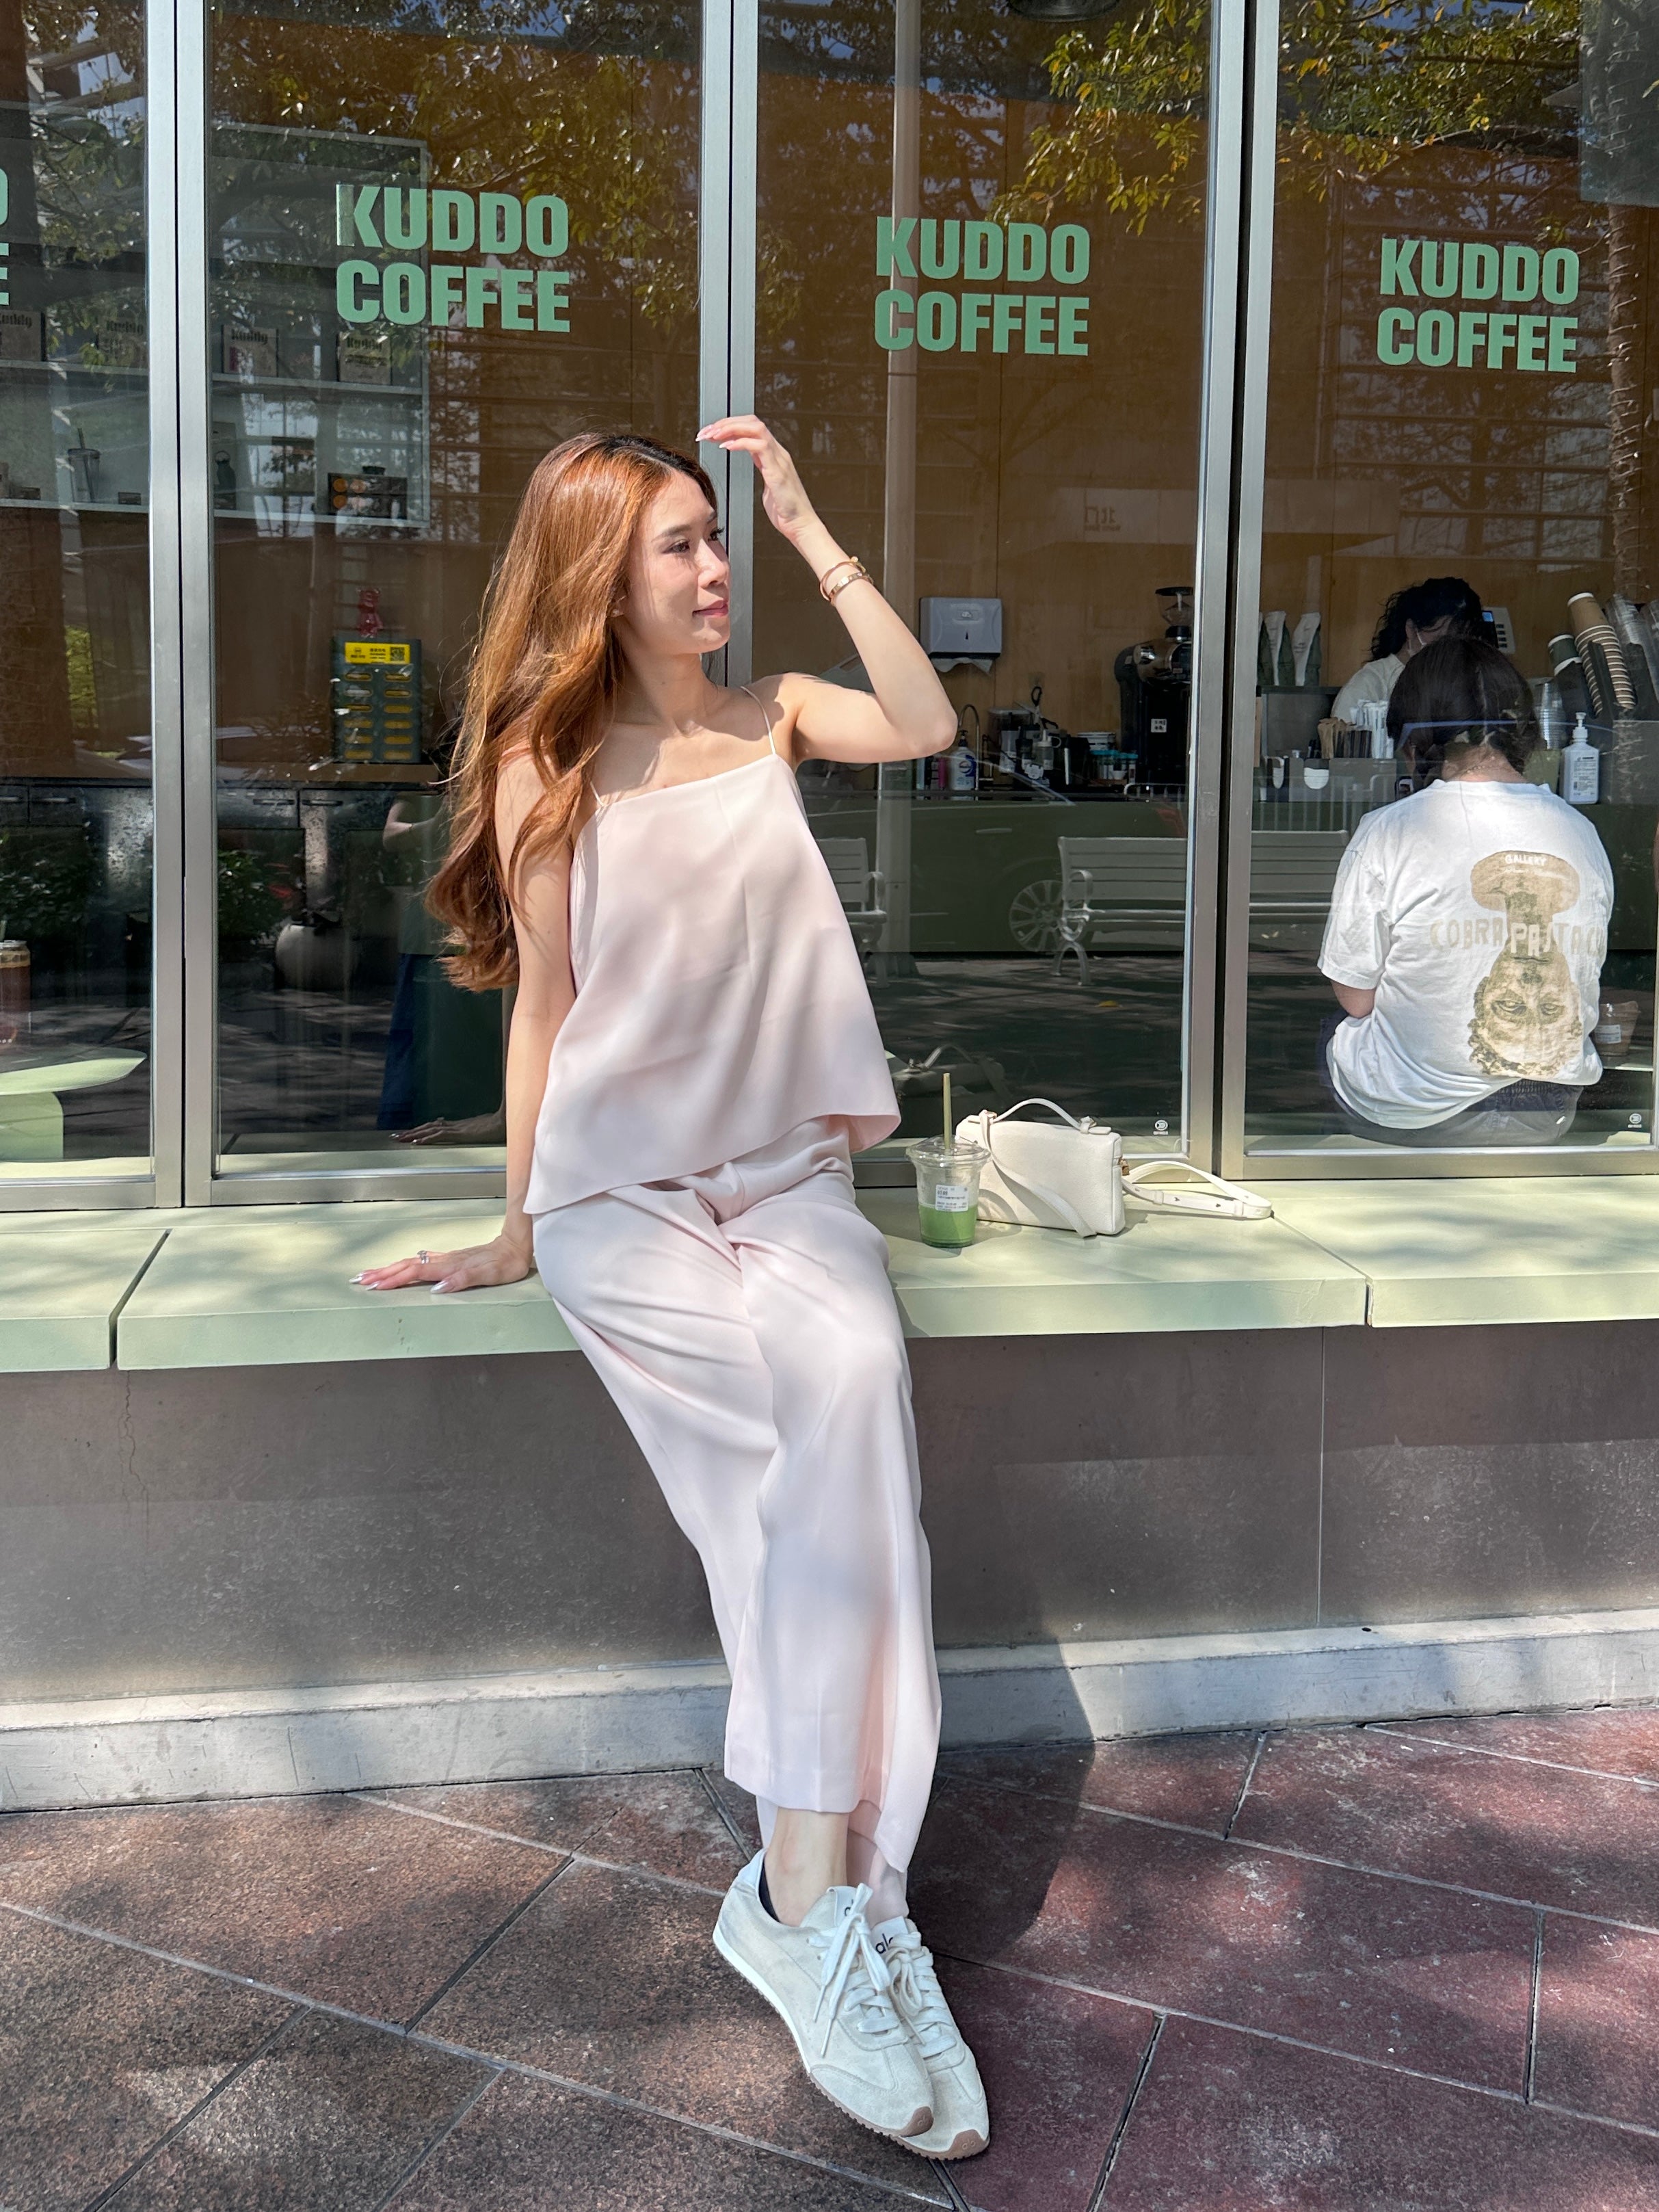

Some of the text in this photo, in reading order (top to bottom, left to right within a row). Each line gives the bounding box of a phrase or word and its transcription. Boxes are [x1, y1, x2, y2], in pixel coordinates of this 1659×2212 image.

[336, 183, 569, 258] KUDDO
[876, 216, 1090, 285] KUDDO
[336, 260, 570, 332] COFFEE
[1380, 238, 1580, 305] KUDDO
[875, 289, 1090, 356] COFFEE
[1377, 307, 1579, 373] COFFEE
[1429, 917, 1504, 950] COBRA
[875, 1932, 894, 1954] al
